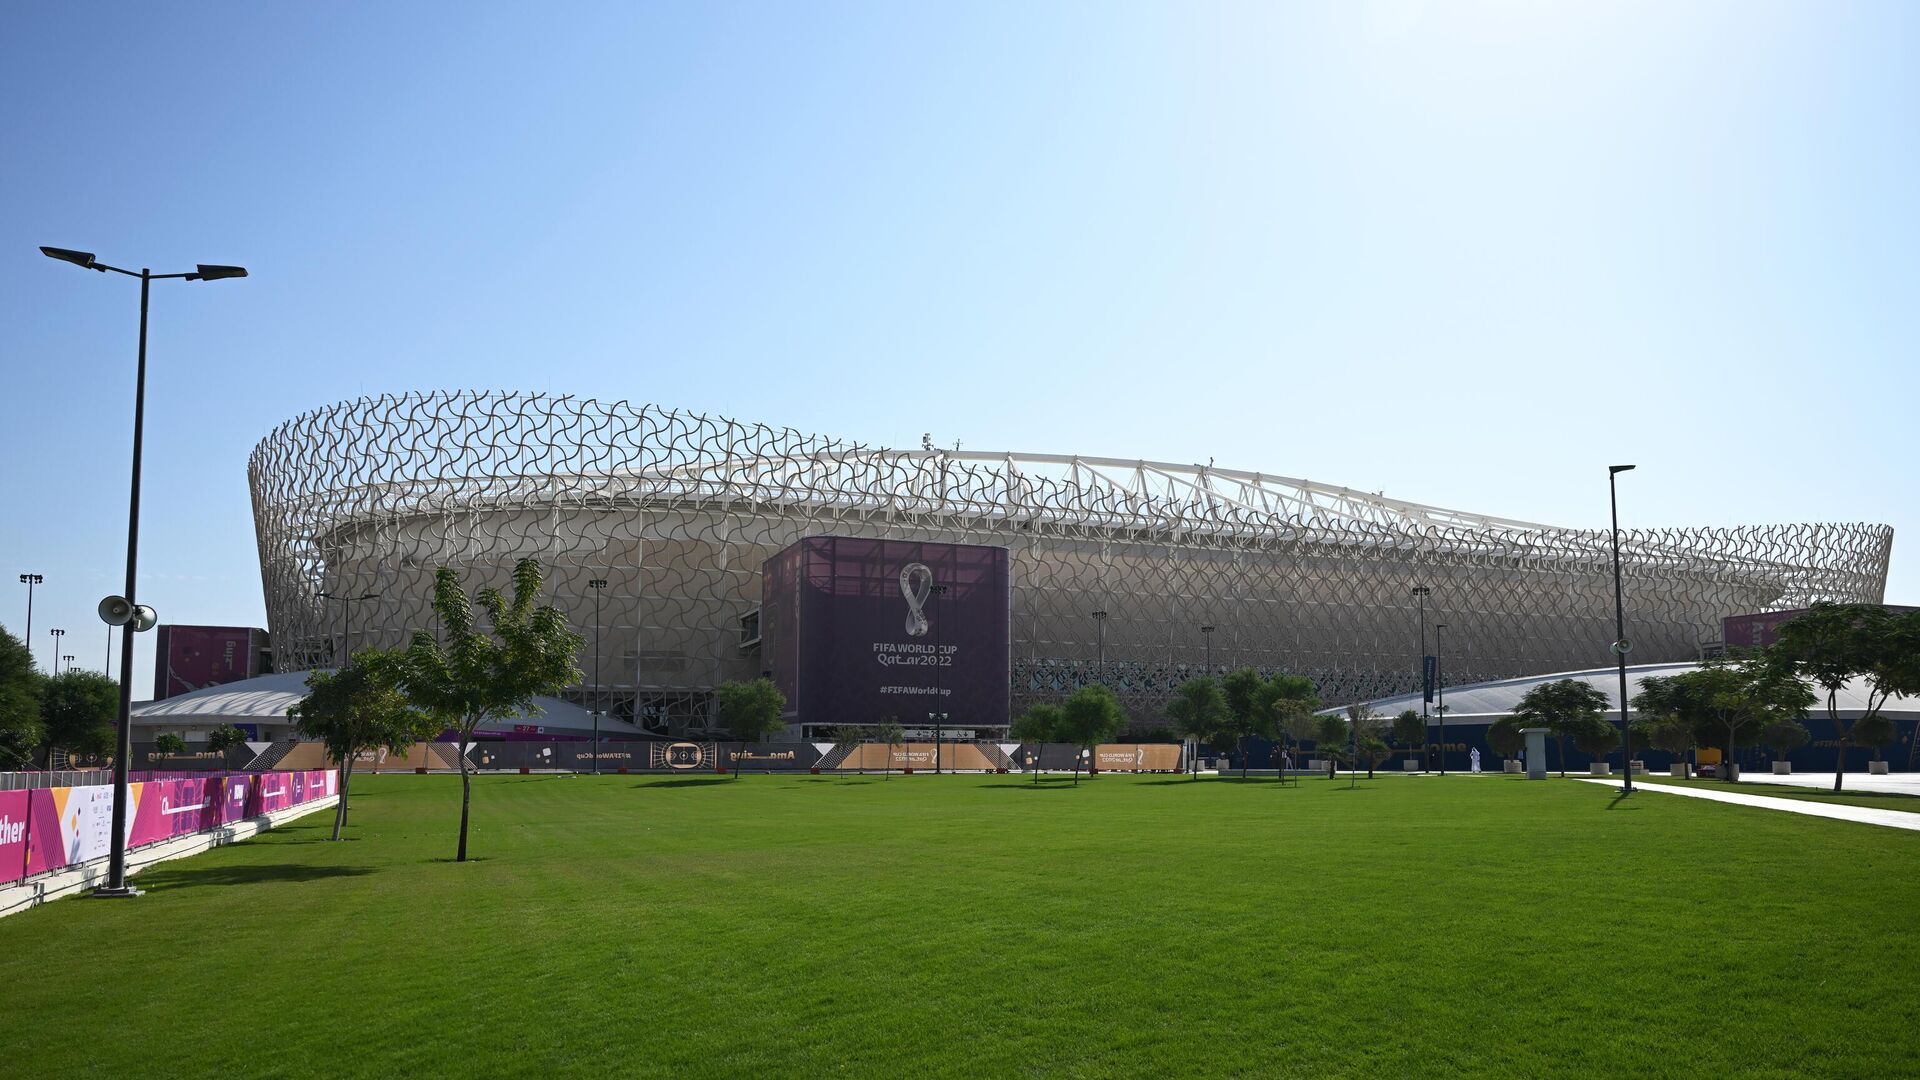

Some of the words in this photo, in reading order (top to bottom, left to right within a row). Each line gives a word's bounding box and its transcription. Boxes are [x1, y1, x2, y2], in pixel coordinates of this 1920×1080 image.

[873, 643, 896, 652] FIFA
[897, 643, 936, 654] WORLD
[939, 645, 958, 655] CUP
